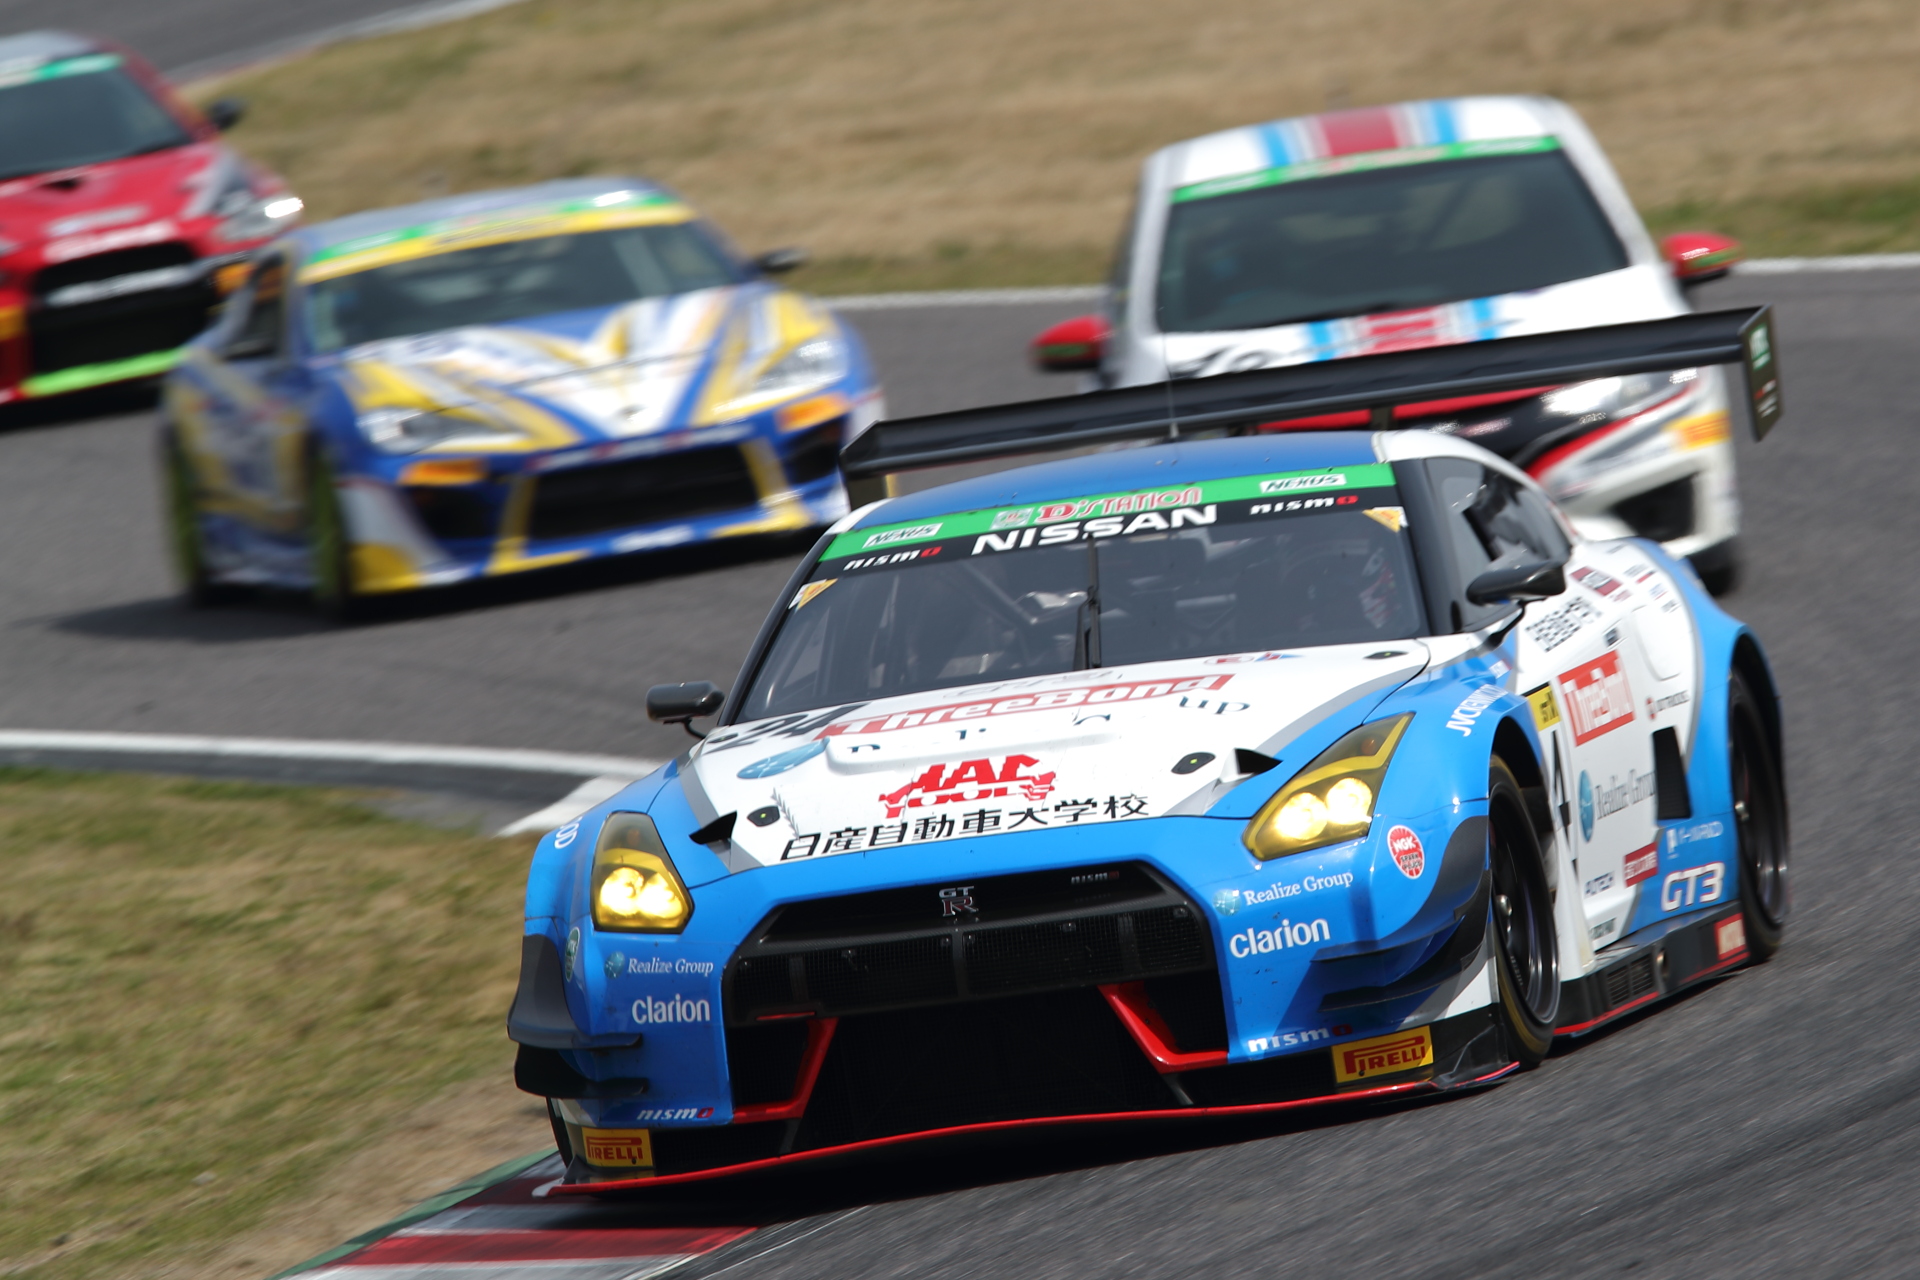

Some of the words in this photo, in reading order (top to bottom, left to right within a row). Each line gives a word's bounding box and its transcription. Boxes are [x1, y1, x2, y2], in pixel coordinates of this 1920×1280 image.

[1265, 475, 1340, 491] NEXUS
[1250, 494, 1359, 515] nismo
[868, 526, 936, 546] NEXUS
[972, 503, 1218, 555] NISSAN
[843, 546, 942, 571] nismo
[832, 674, 1226, 734] ThreeBond
[780, 794, 1150, 861] 日産自動車大学校
[1392, 836, 1417, 853] NGK
[939, 885, 975, 898] GT
[1243, 881, 1302, 906] Realize
[1303, 871, 1354, 893] Group
[1661, 861, 1725, 913] GT3
[627, 957, 673, 974] Realize
[674, 958, 714, 979] Group
[1247, 1024, 1352, 1052] nismo
[1343, 1035, 1427, 1074] PIRELLI
[636, 1106, 714, 1121] nismo
[586, 1136, 644, 1160] PIRELLI
